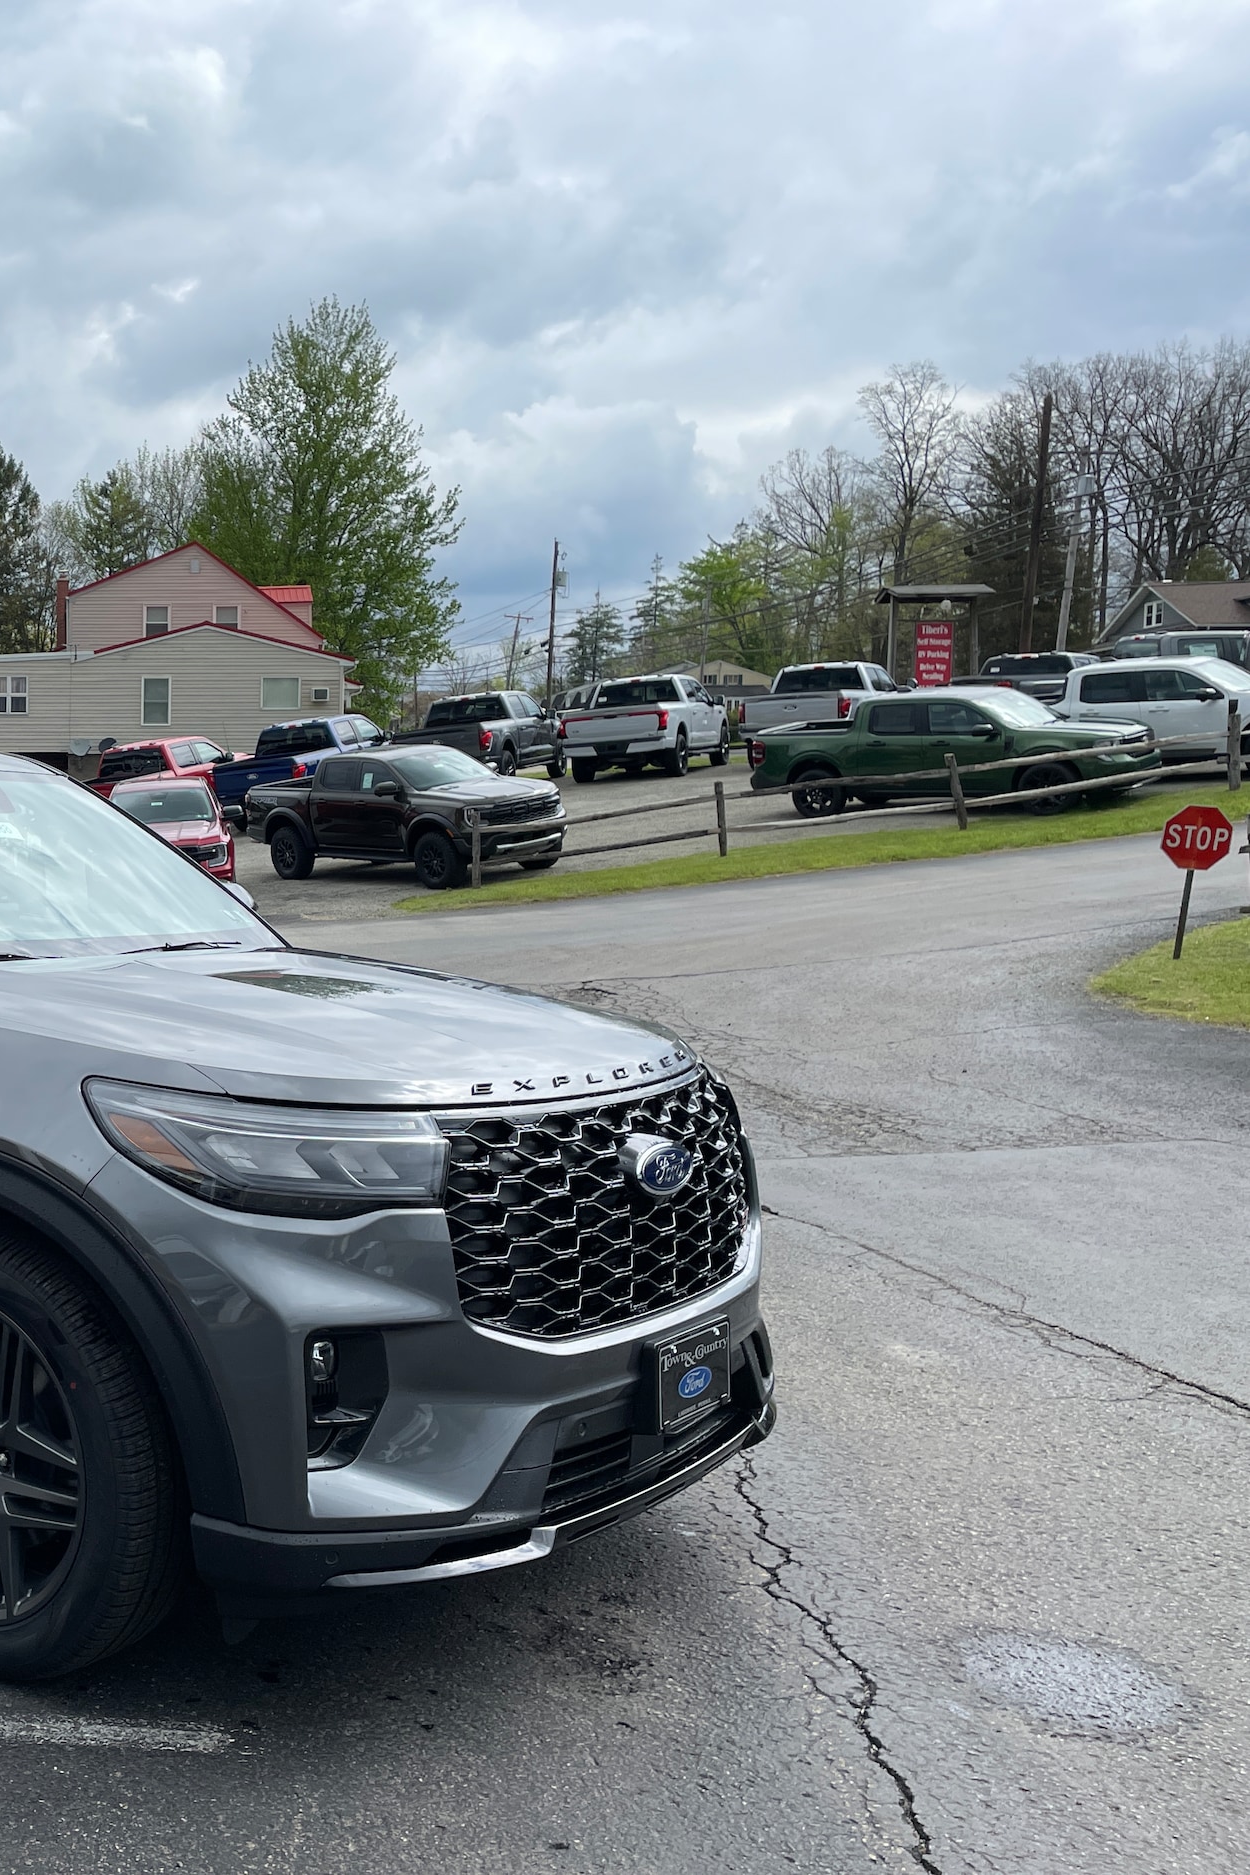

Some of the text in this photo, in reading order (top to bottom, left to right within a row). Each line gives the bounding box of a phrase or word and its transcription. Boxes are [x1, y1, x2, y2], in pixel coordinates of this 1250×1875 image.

[917, 638, 951, 647] Self Storage
[918, 650, 949, 659] RV Parking
[936, 663, 946, 671] Way
[1166, 824, 1229, 851] STOP
[471, 1049, 688, 1096] EXPLORER
[655, 1152, 685, 1184] Ford
[661, 1352, 688, 1372] Town
[684, 1371, 706, 1393] Ford
